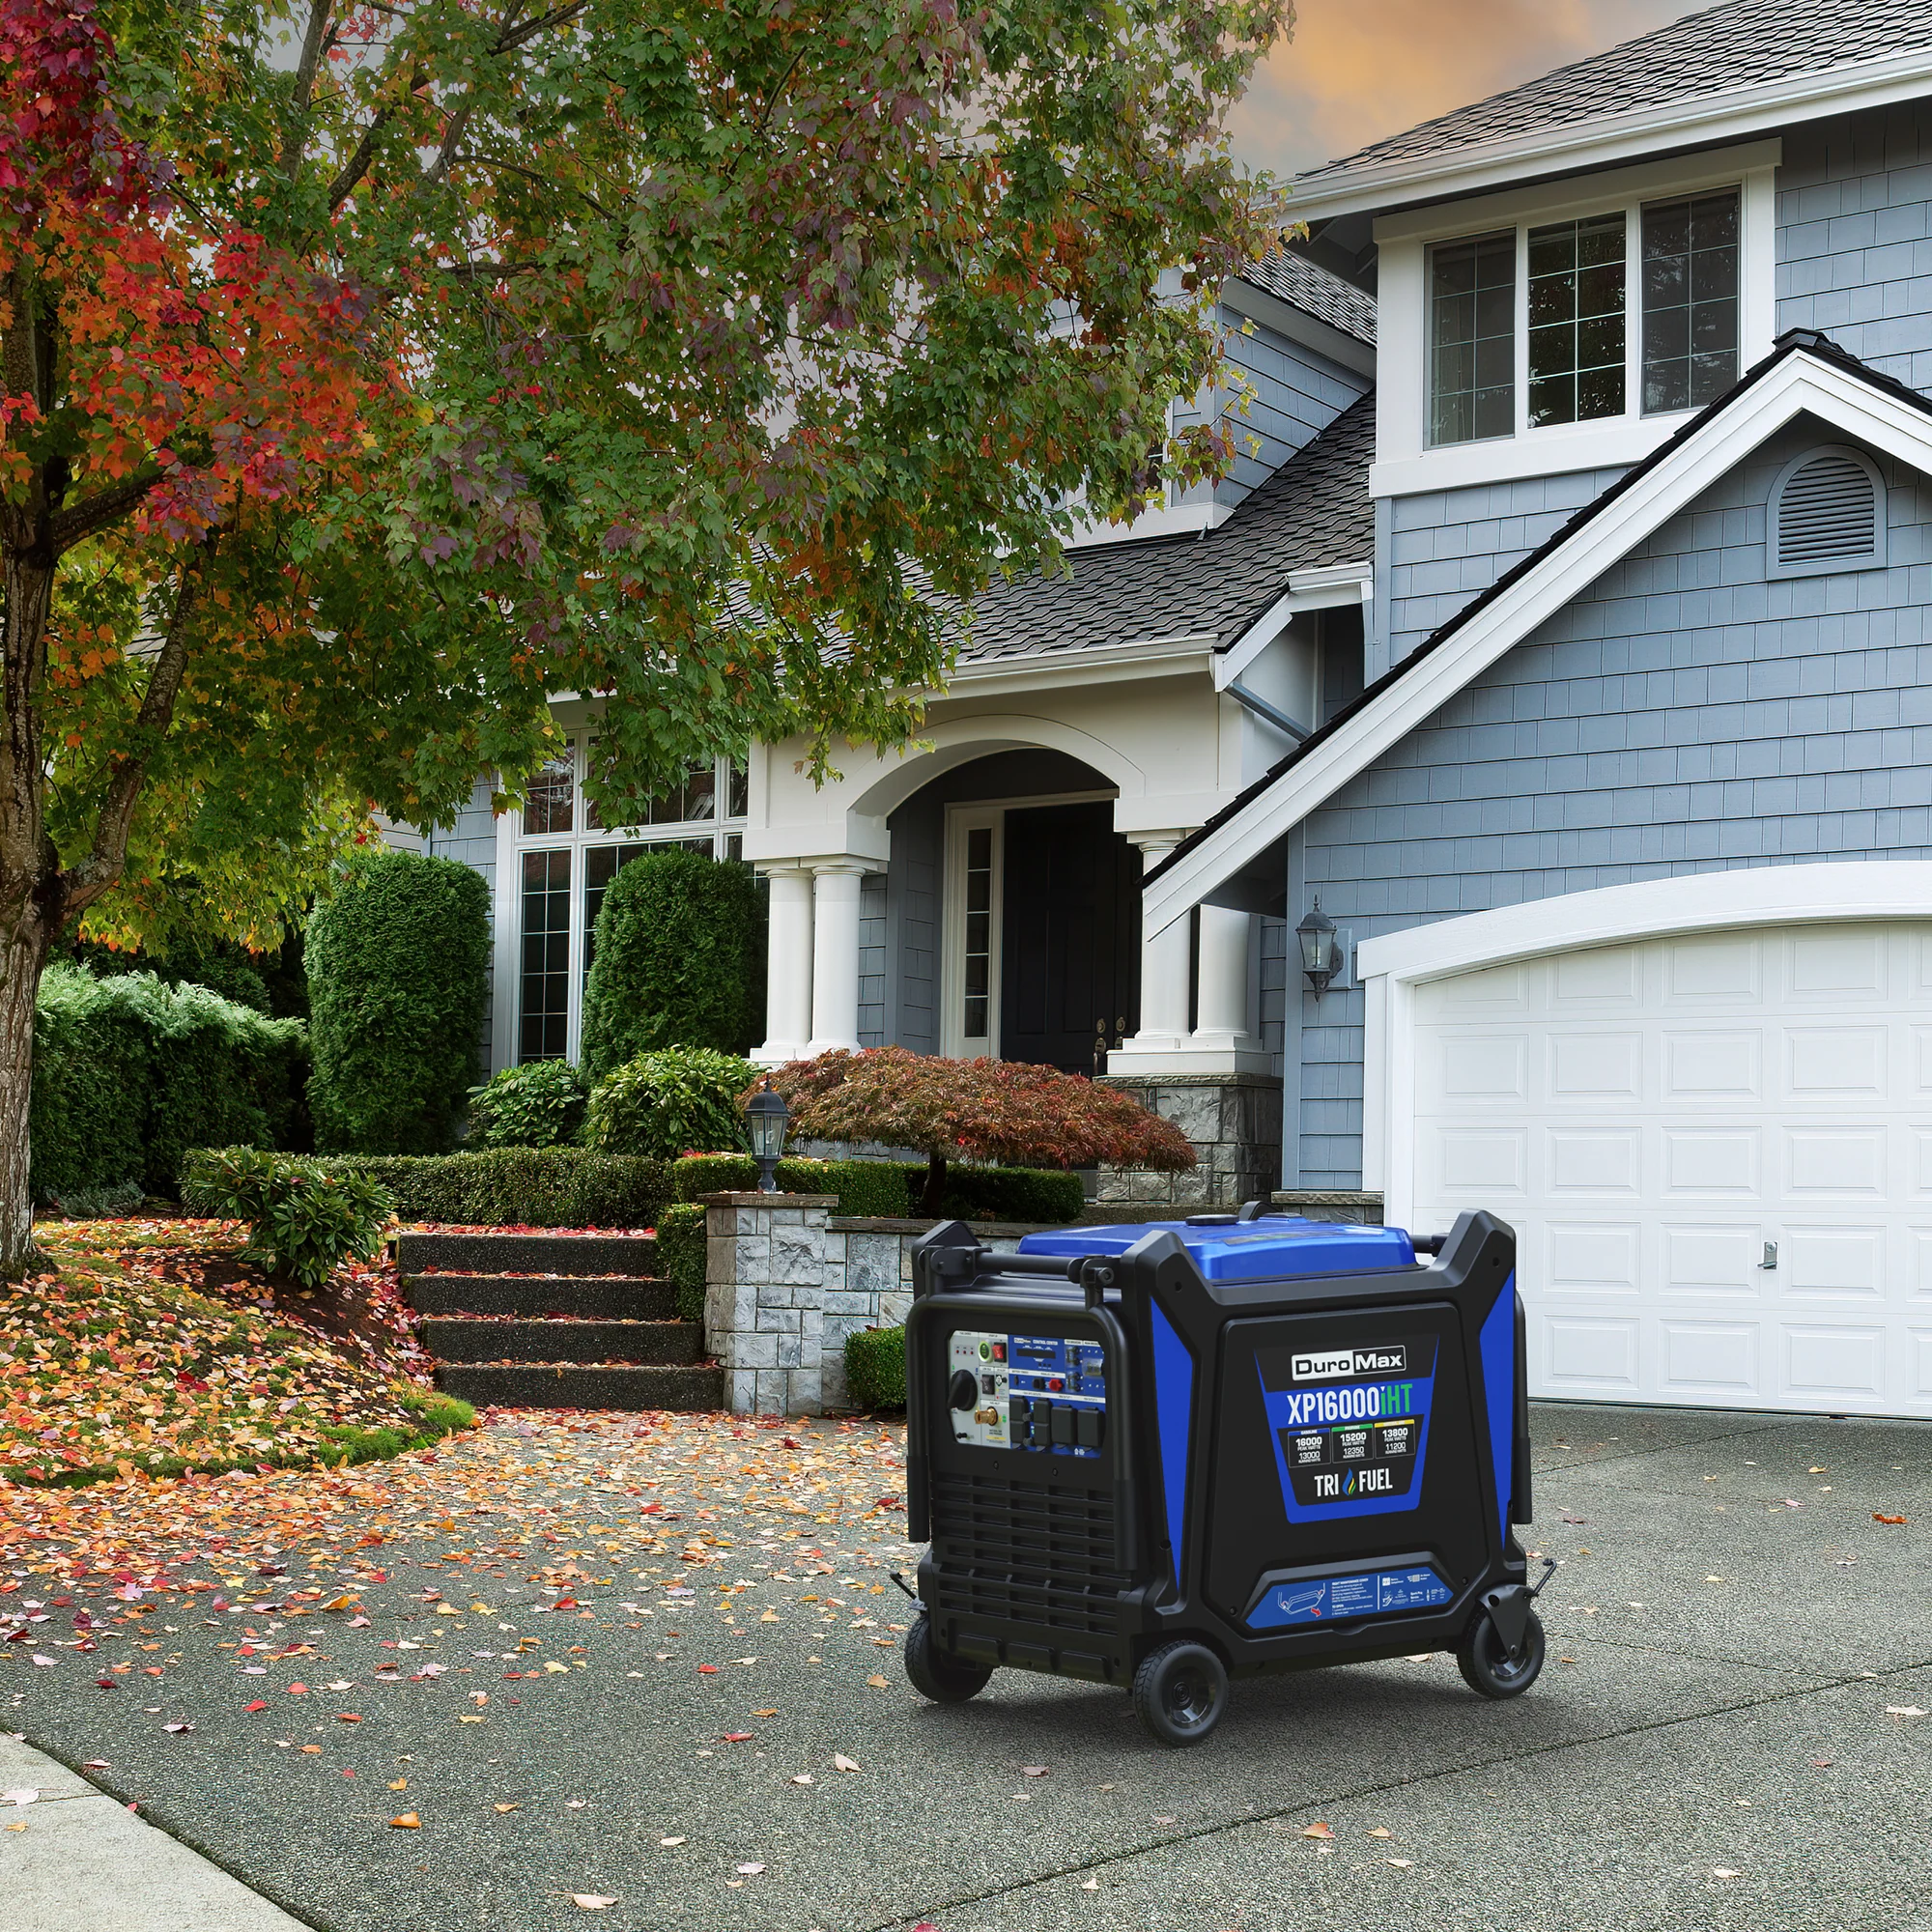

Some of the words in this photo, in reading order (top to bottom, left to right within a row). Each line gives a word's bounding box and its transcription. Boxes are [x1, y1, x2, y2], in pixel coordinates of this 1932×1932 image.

[1287, 1383, 1413, 1425] XP16000iHT
[1340, 1432, 1367, 1442] 15200
[1382, 1428, 1408, 1437] 13800
[1295, 1436, 1322, 1447] 16000
[1385, 1441, 1406, 1451] 11200
[1299, 1451, 1321, 1460] 13000
[1343, 1446, 1365, 1456] 12350
[1314, 1473, 1340, 1497] TRI
[1358, 1467, 1393, 1492] FUEL
